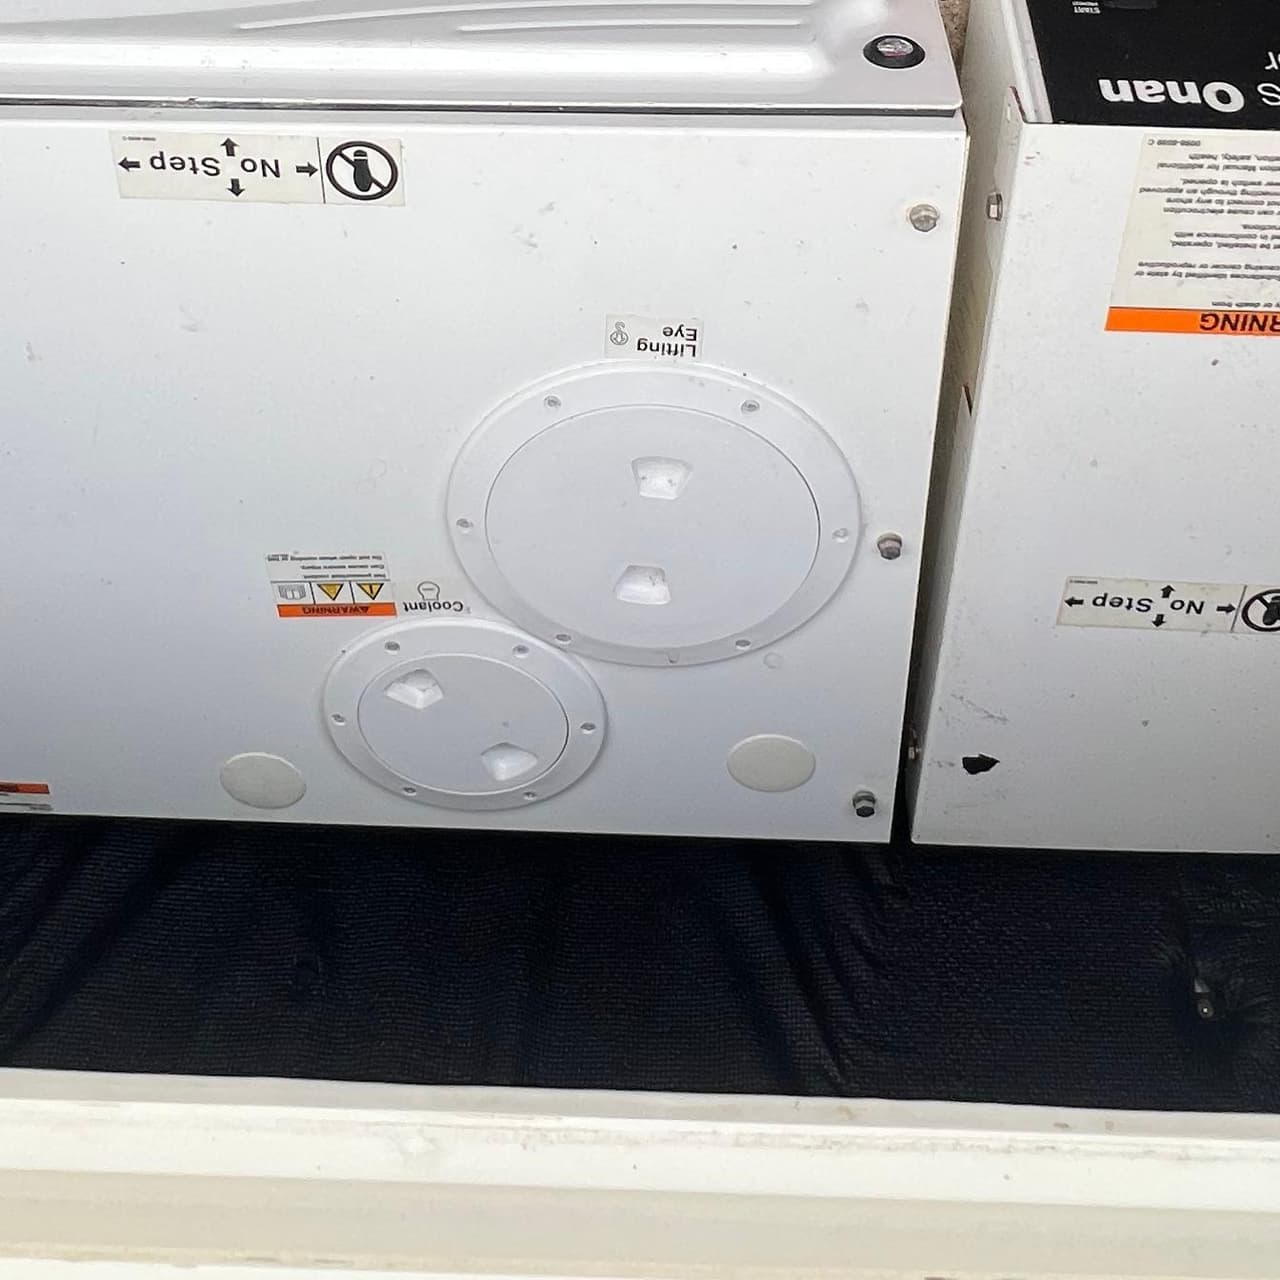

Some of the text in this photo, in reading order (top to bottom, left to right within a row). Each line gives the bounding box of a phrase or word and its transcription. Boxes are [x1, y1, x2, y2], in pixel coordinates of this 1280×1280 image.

[1098, 78, 1246, 113] Onan
[150, 151, 280, 178] No Step
[662, 324, 697, 341] Eye
[636, 338, 696, 357] Lifting
[302, 606, 360, 614] WARNING
[402, 601, 463, 612] Coolant
[1092, 592, 1204, 614] No Step
